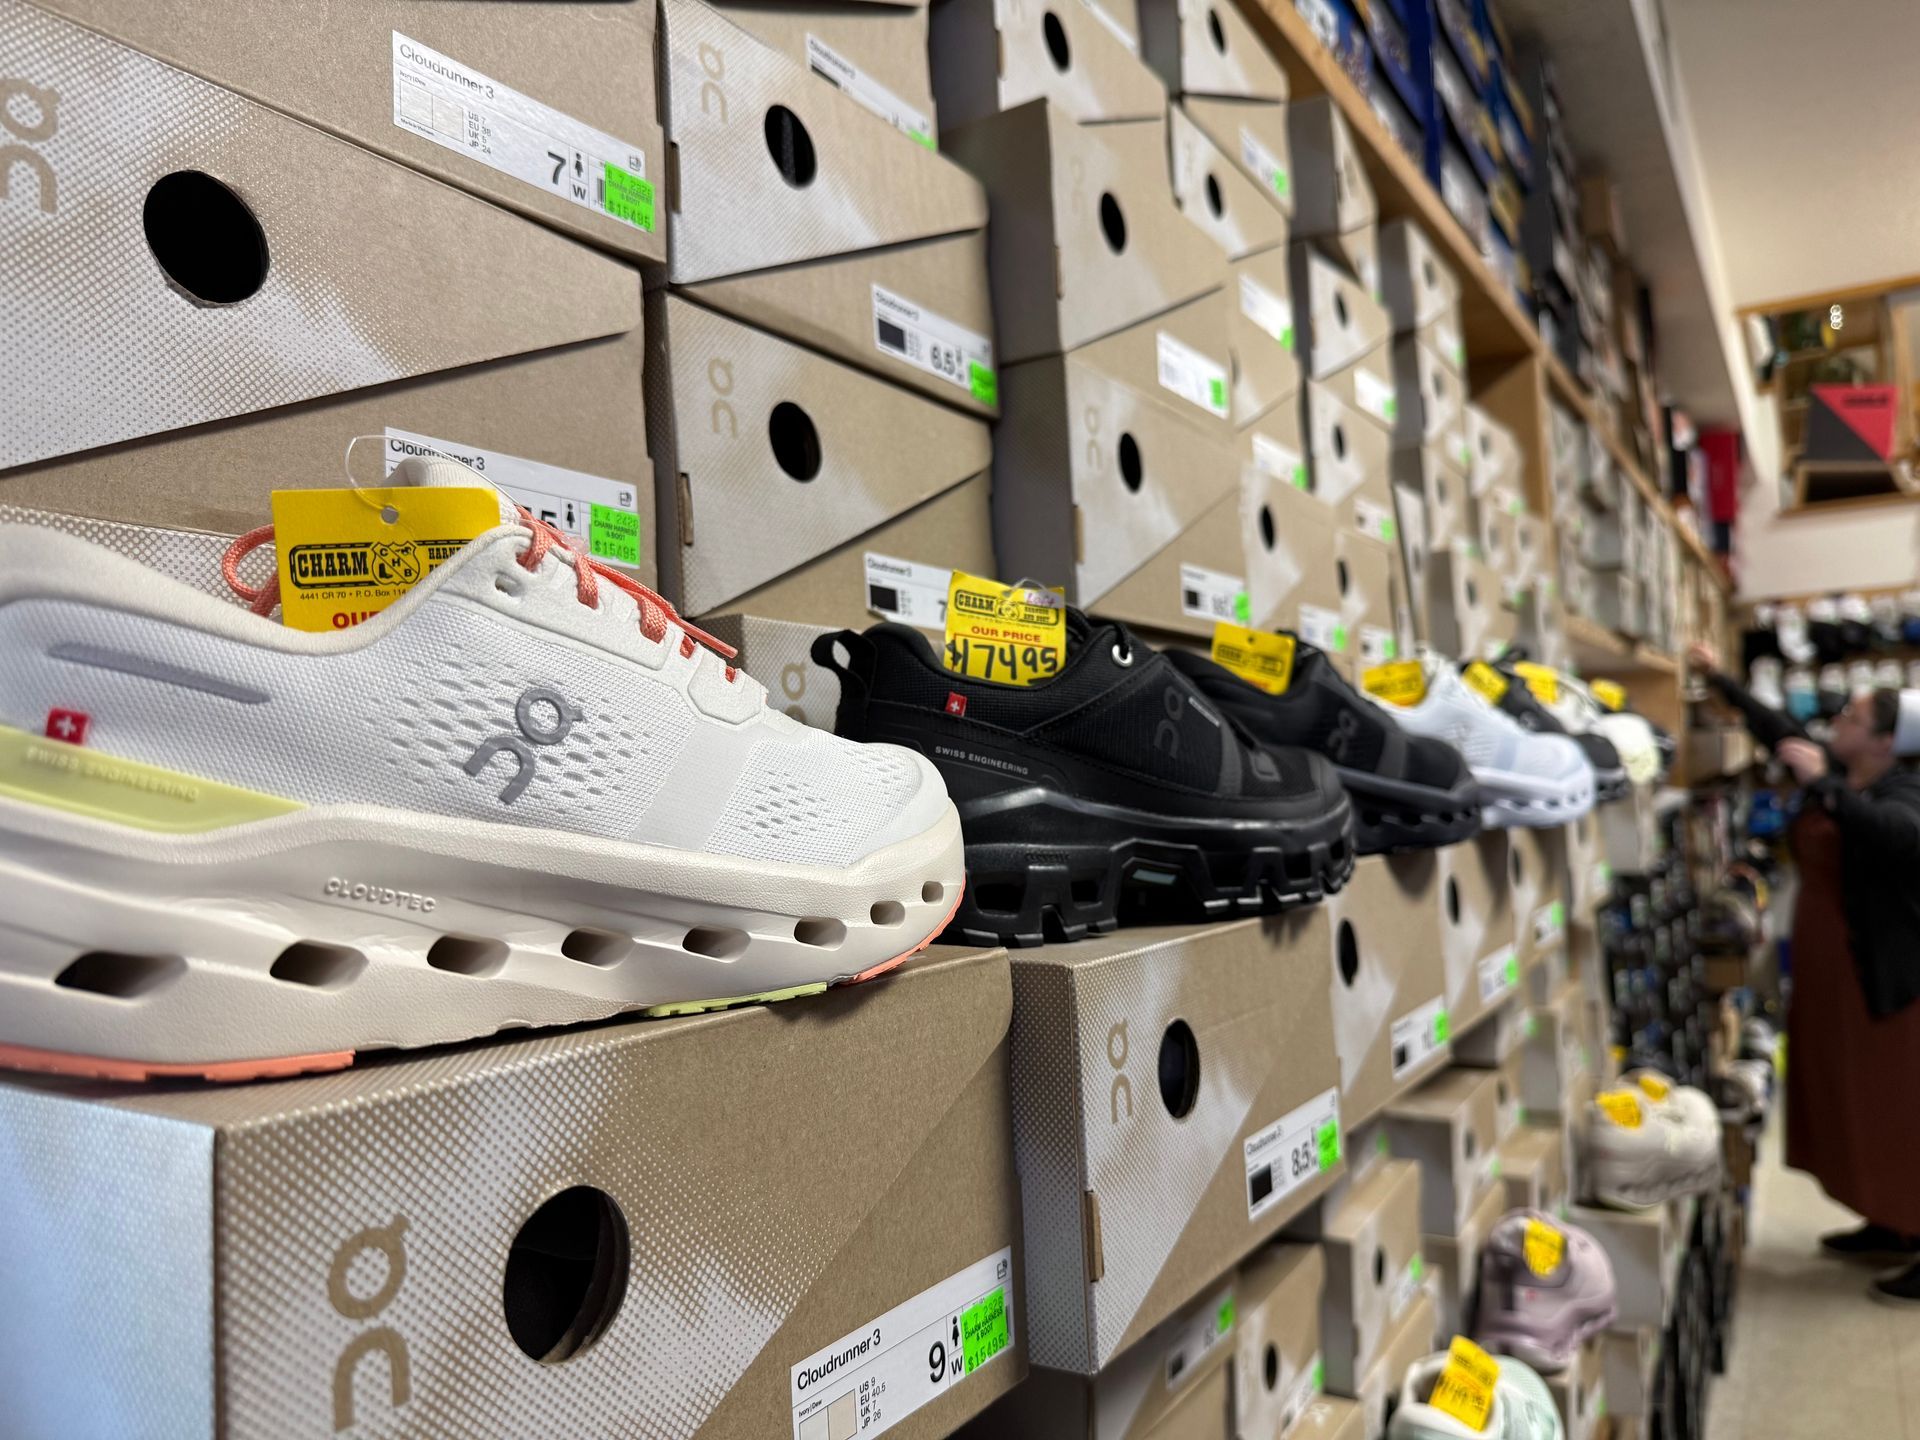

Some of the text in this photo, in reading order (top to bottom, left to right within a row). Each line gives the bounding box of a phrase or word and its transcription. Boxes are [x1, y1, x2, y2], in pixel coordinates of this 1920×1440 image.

[399, 43, 495, 100] Cloudrunner 3
[547, 151, 567, 186] 7
[572, 184, 587, 201] W
[476, 457, 486, 471] 3
[297, 551, 370, 578] CHARM
[300, 592, 319, 600] 4441
[321, 591, 335, 599] CR
[337, 591, 347, 599] 70
[375, 589, 390, 597] Box
[957, 593, 995, 613] CHARM
[332, 610, 381, 630] OU
[971, 625, 1041, 643] OUR PRICE
[934, 745, 1029, 776] SWISS ENGINEERING
[323, 876, 437, 913] CLOUDTEC
[797, 1328, 881, 1391] Cloudrunner 3
[929, 1340, 946, 1383] 9
[967, 1331, 1005, 1373] $15495
[951, 1354, 963, 1376] W
[859, 1376, 876, 1394] US 9
[860, 1382, 886, 1406] EU 40.5
[860, 1399, 878, 1418] UK 7
[861, 1409, 883, 1430] JP 26
